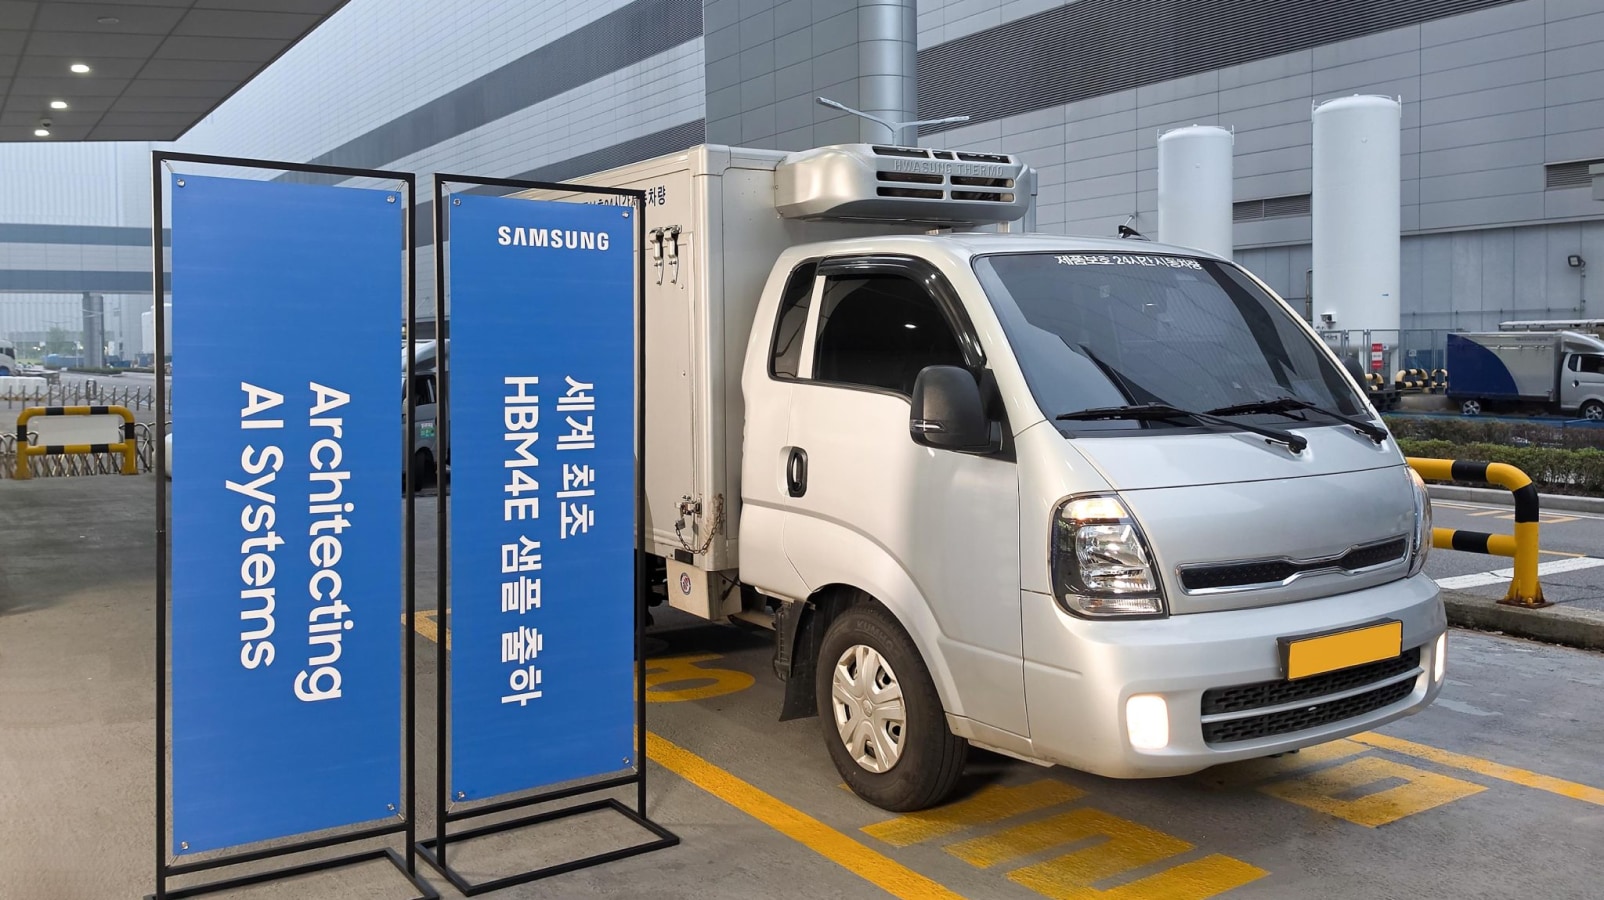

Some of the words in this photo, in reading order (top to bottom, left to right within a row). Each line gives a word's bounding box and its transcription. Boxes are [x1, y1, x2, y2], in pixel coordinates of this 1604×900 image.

[894, 159, 952, 174] HWASUNG
[957, 164, 1004, 177] THERMO
[498, 226, 609, 251] SAMSUNG
[241, 381, 285, 430] AI
[556, 375, 595, 450] 세계
[504, 376, 540, 521] HBM4E
[556, 463, 595, 540] 최초
[226, 444, 285, 670] Systems
[294, 381, 354, 702] Architecting
[501, 535, 542, 615] 샘플
[501, 625, 543, 707] 출하
